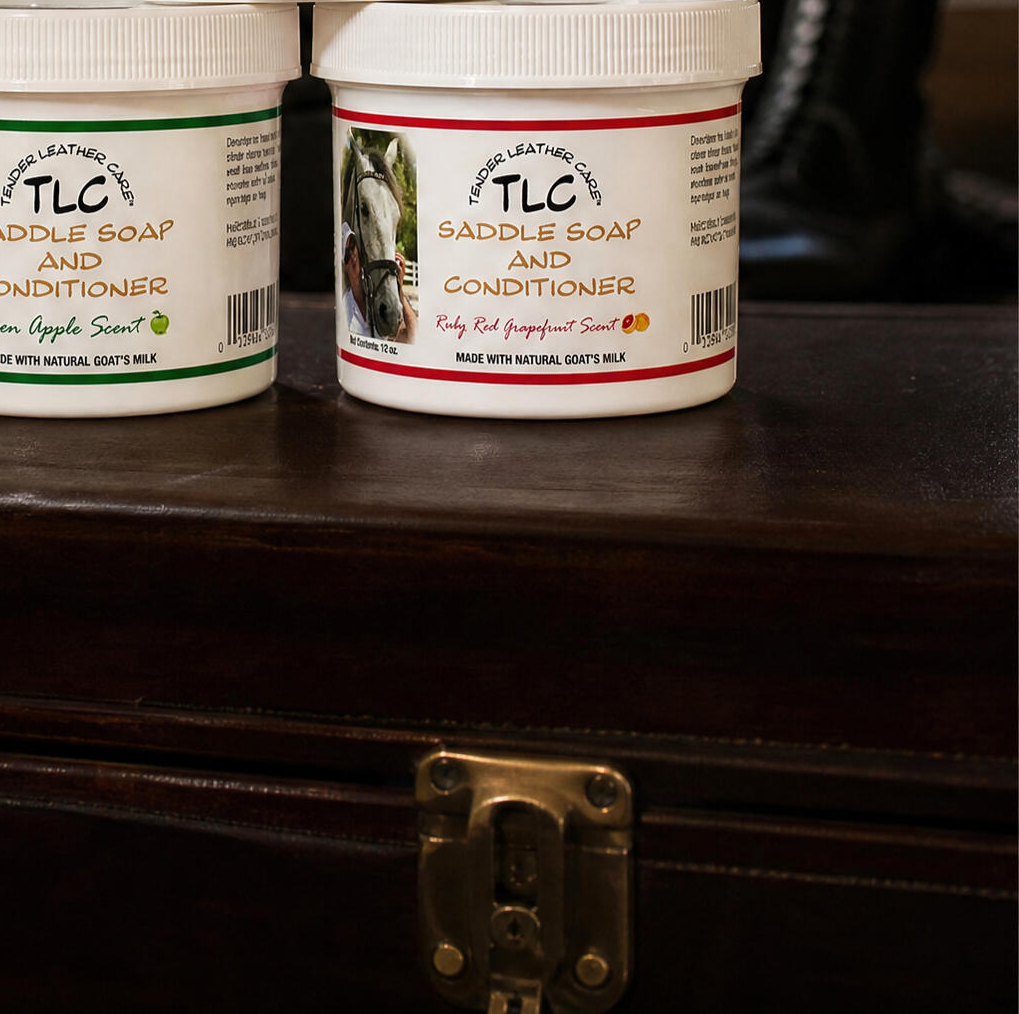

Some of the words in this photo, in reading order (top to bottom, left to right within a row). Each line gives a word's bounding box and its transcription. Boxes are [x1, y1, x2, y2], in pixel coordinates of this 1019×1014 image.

[1, 155, 37, 206] TENDER
[38, 144, 106, 165] LEATHER
[469, 153, 506, 206] TENDER
[507, 143, 574, 164] LEATHER
[23, 175, 108, 214] TLC
[492, 174, 576, 213] TLC
[98, 220, 174, 242] SOAP
[439, 221, 555, 241] SADDLE
[567, 218, 641, 241] SOAP
[38, 252, 102, 272] AND
[508, 250, 571, 270] AND
[444, 276, 635, 296] CONDITIONER
[29, 315, 82, 344] Apple
[91, 315, 145, 337] Scent
[436, 315, 467, 339] Ruby
[474, 317, 499, 334] Red
[504, 318, 577, 340] Grapefruit
[580, 317, 620, 334] Scent
[15, 355, 40, 366] WITH
[44, 356, 90, 366] NATURAL
[94, 355, 130, 366] GOAT'S
[133, 353, 156, 364] MILK
[456, 352, 484, 364] MADE
[487, 354, 512, 364] WITH
[516, 355, 562, 365] NATURAL
[565, 354, 600, 365] GOAT'S
[603, 352, 625, 363] MILK
